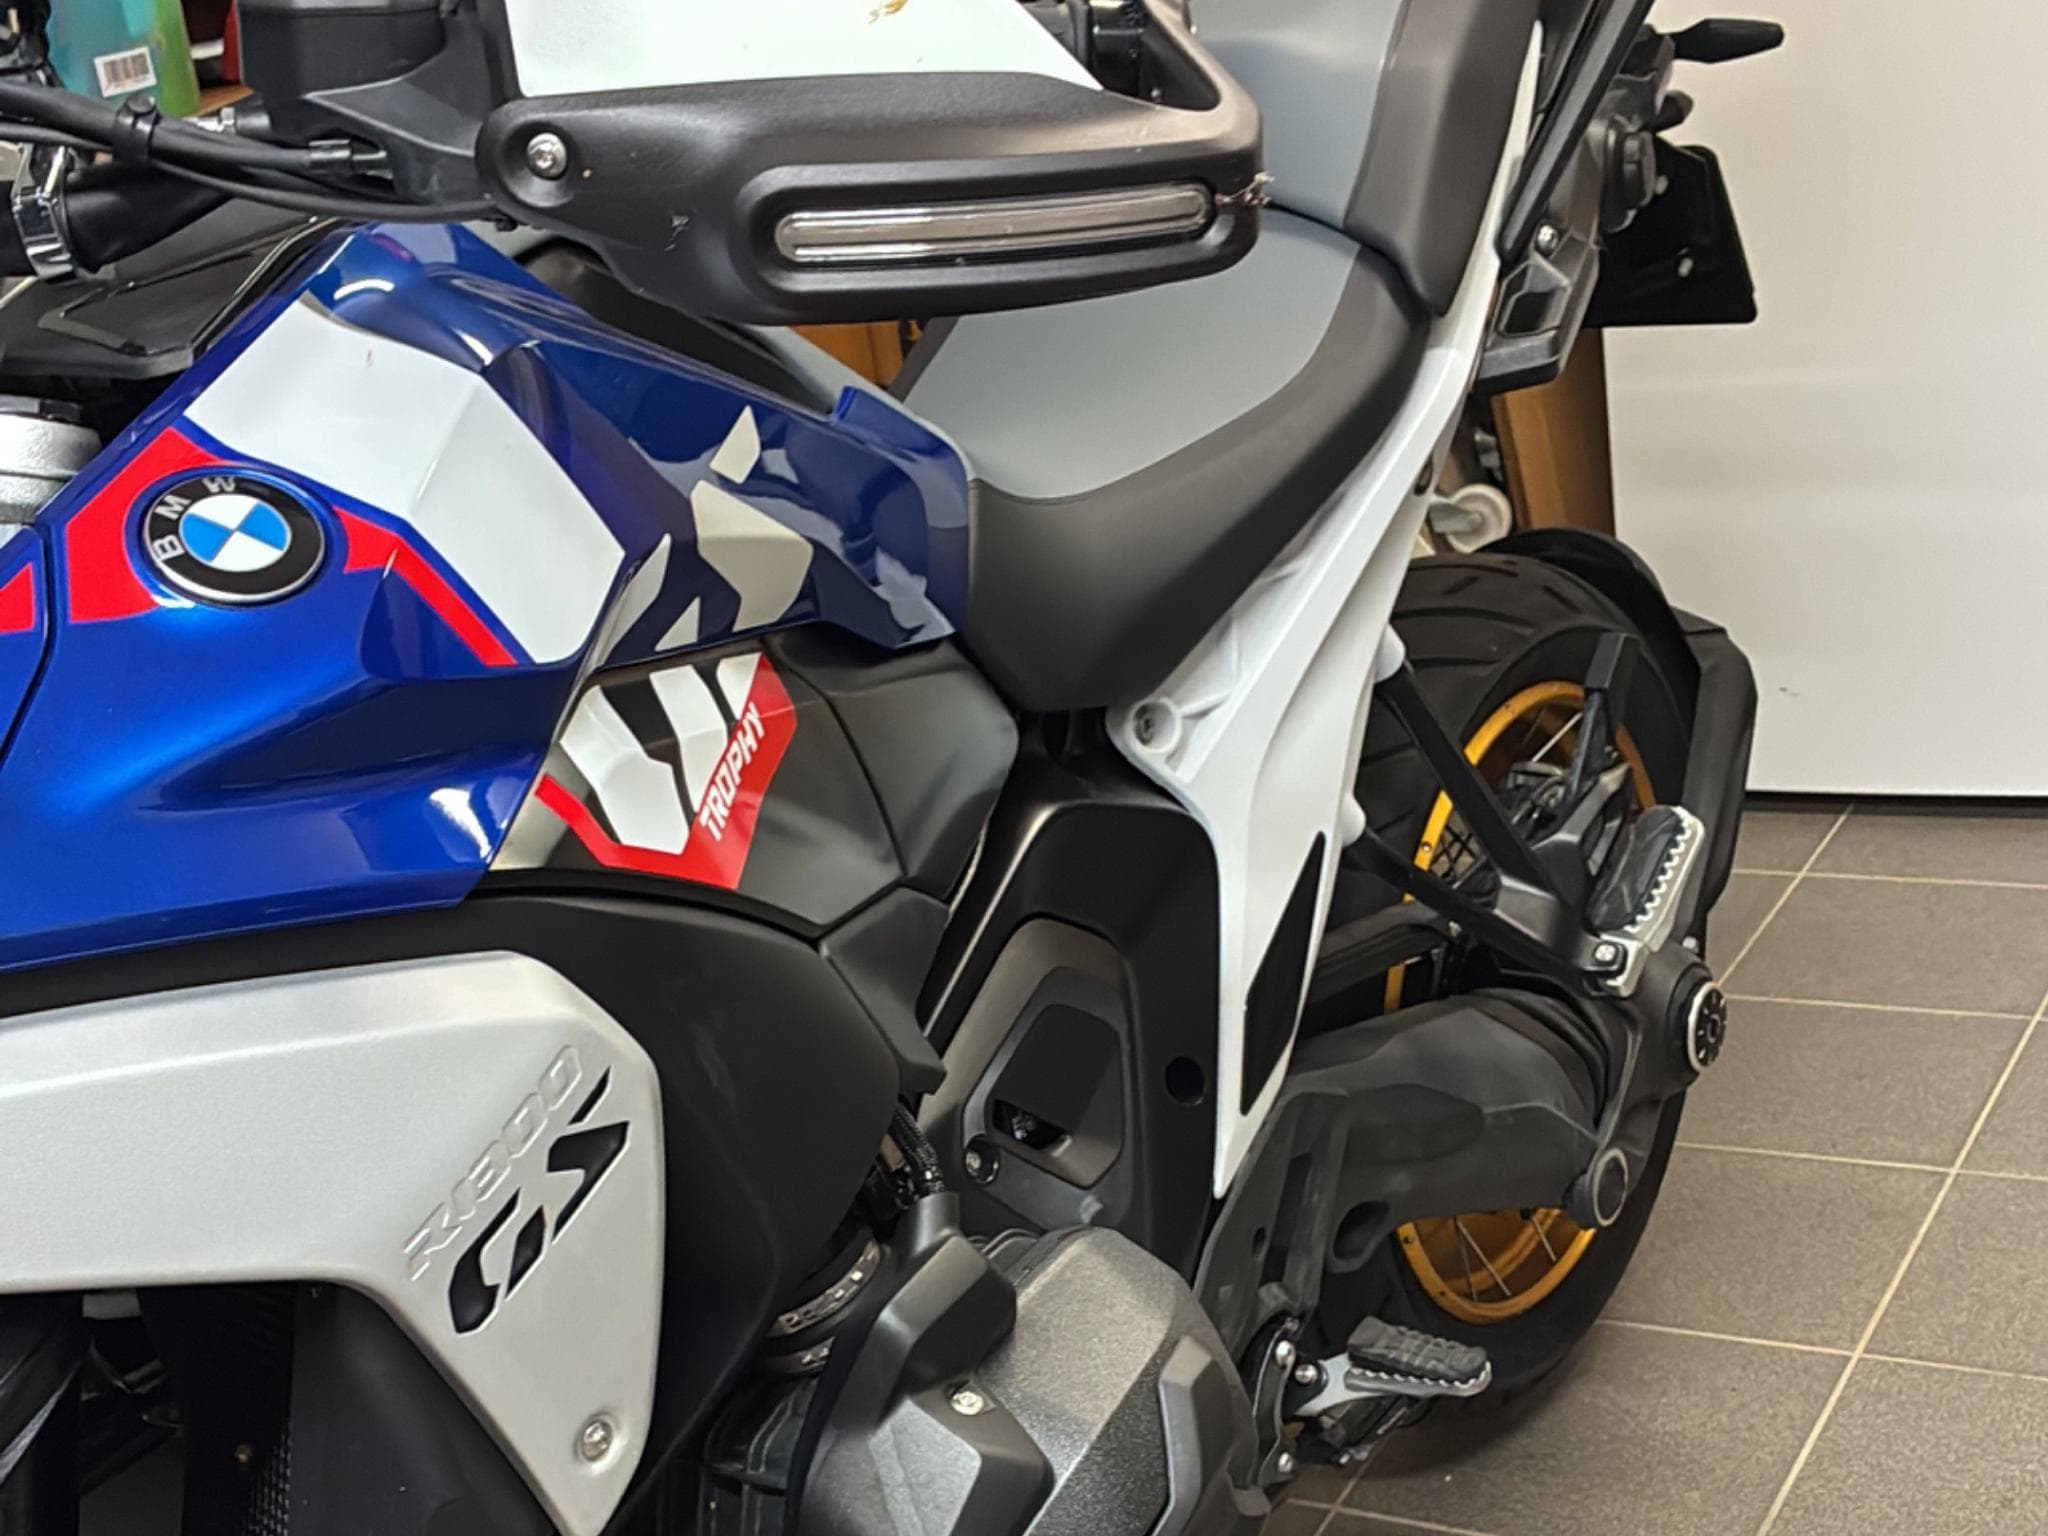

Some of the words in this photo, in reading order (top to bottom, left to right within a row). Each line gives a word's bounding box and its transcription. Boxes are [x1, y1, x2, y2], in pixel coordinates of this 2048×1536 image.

[153, 476, 235, 561] BMW
[699, 701, 765, 841] TROPHY
[448, 1066, 630, 1335] GS
